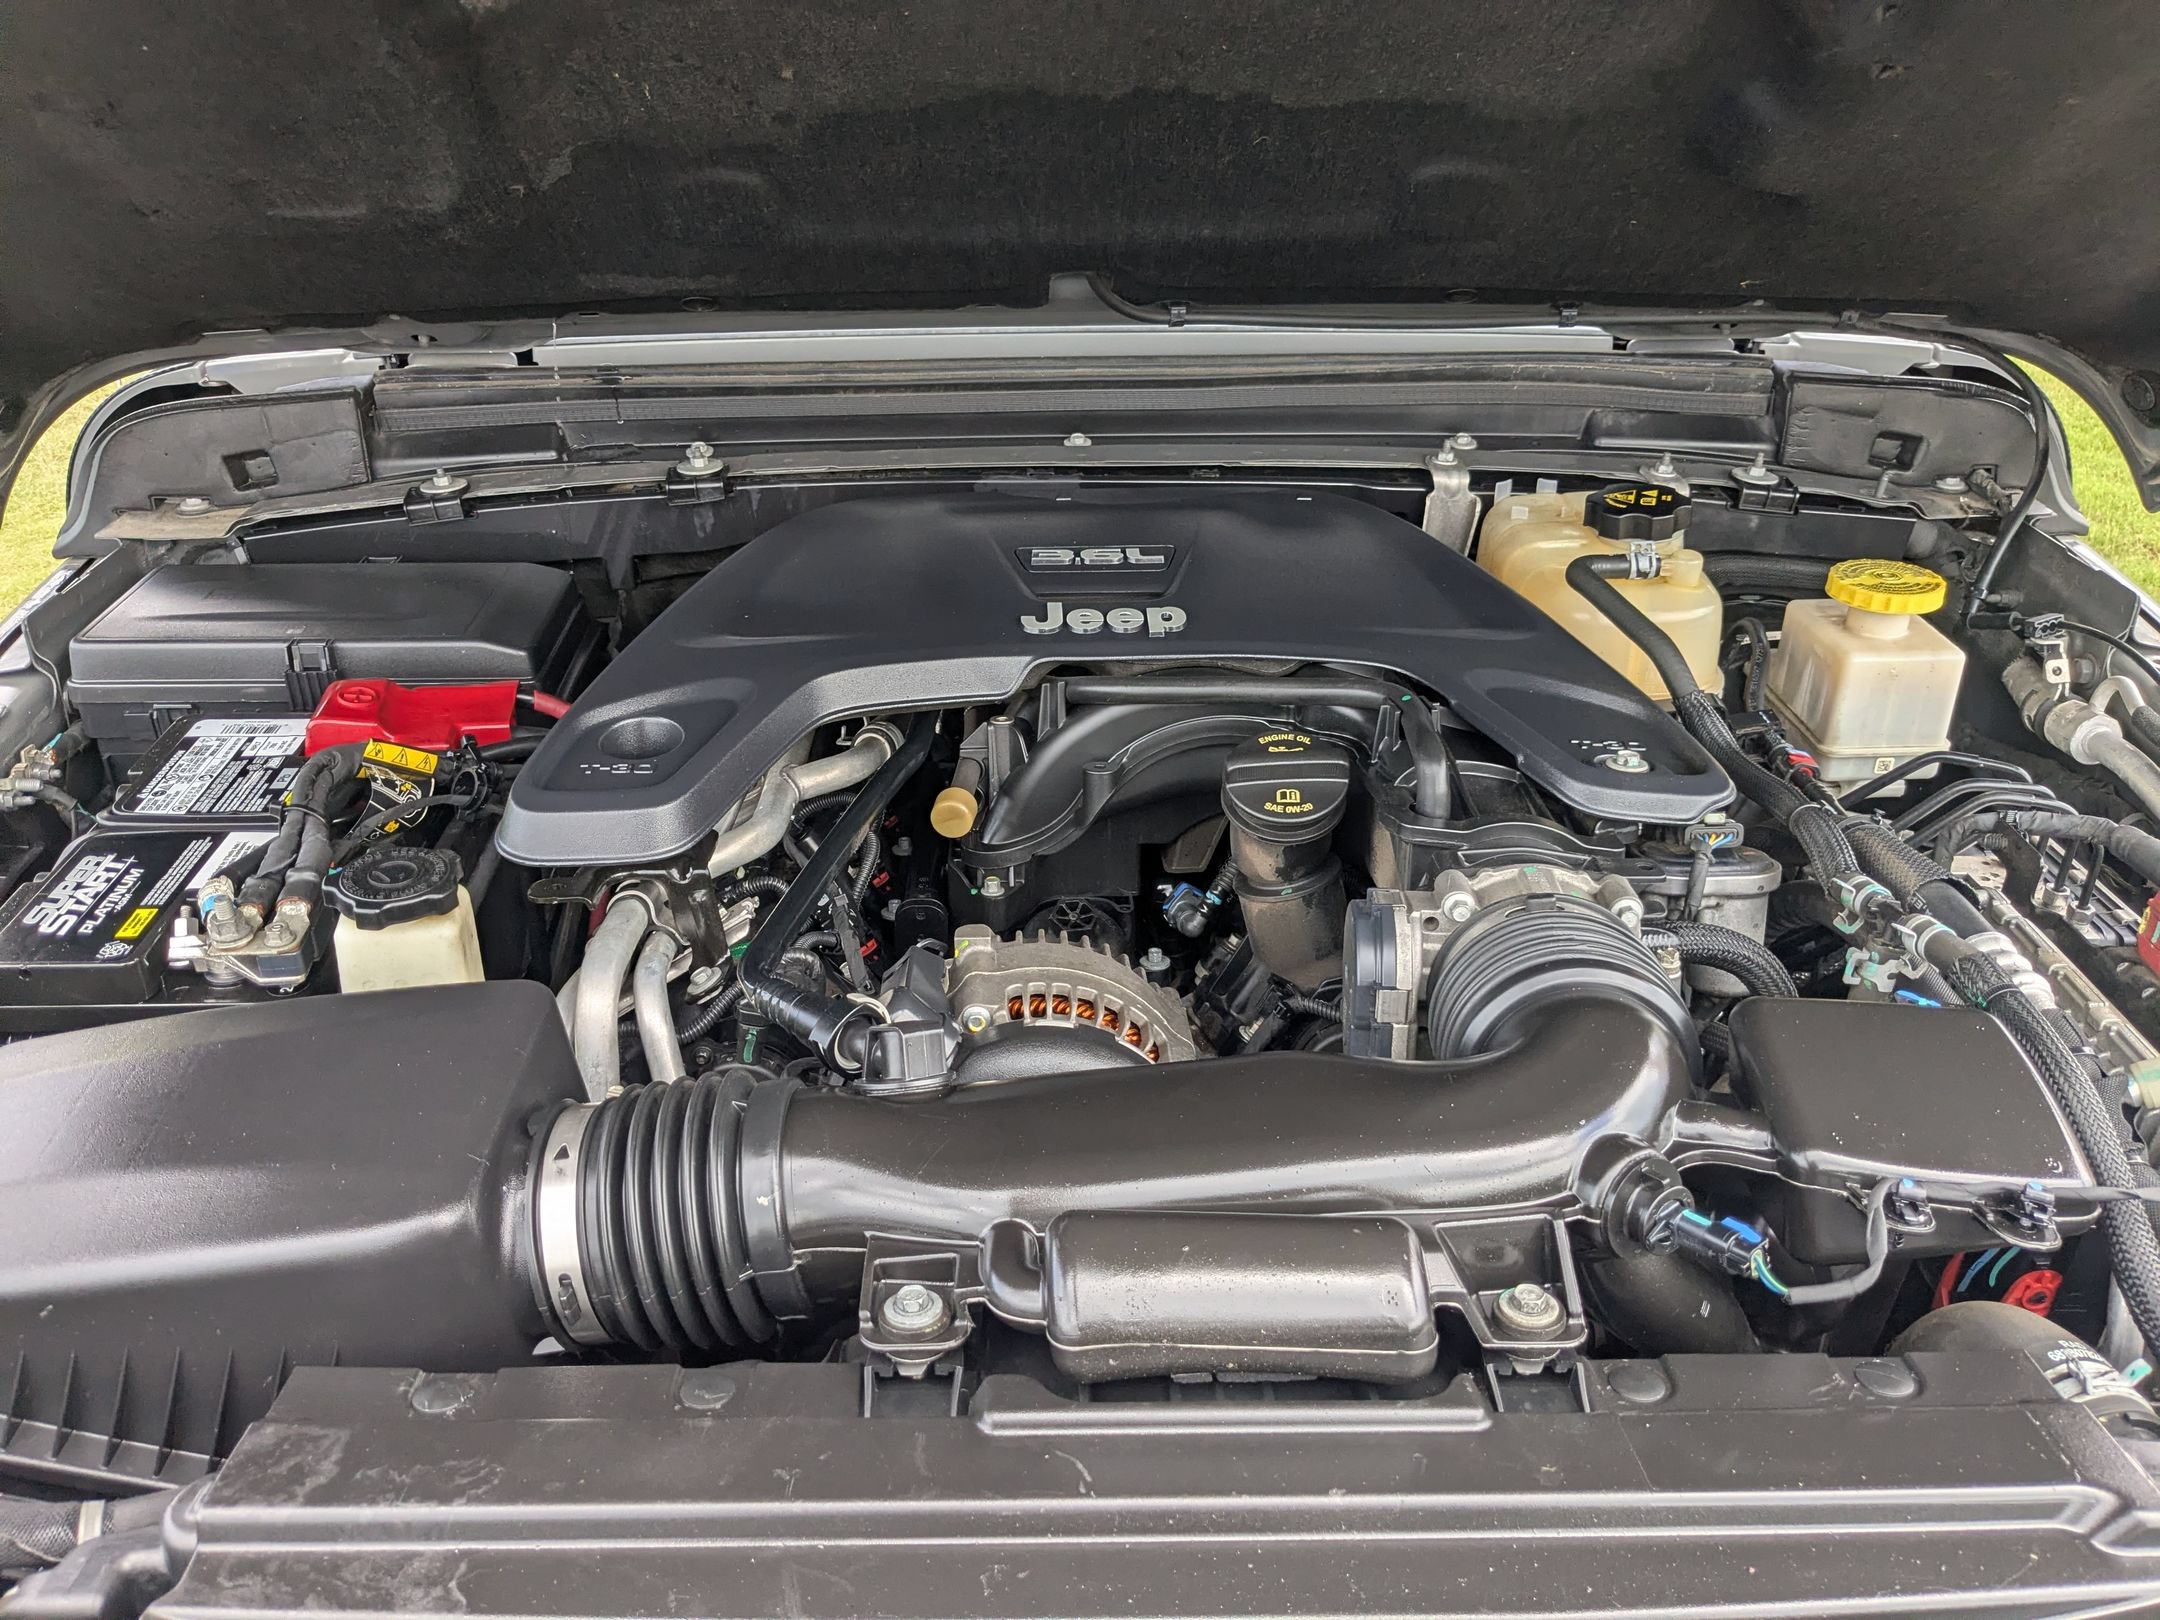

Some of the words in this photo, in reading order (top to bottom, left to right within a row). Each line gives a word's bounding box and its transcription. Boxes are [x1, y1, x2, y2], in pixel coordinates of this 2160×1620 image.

[1030, 548, 1165, 566] 3.6L
[1020, 601, 1187, 638] Jeep
[1258, 733, 1295, 745] ENGINE
[1296, 733, 1313, 746] OIL
[1263, 802, 1284, 813] SAE
[1285, 802, 1314, 814] 0W-20
[22, 854, 104, 924] SUPER
[38, 852, 125, 936] START
[77, 868, 145, 935] PLATINUM
